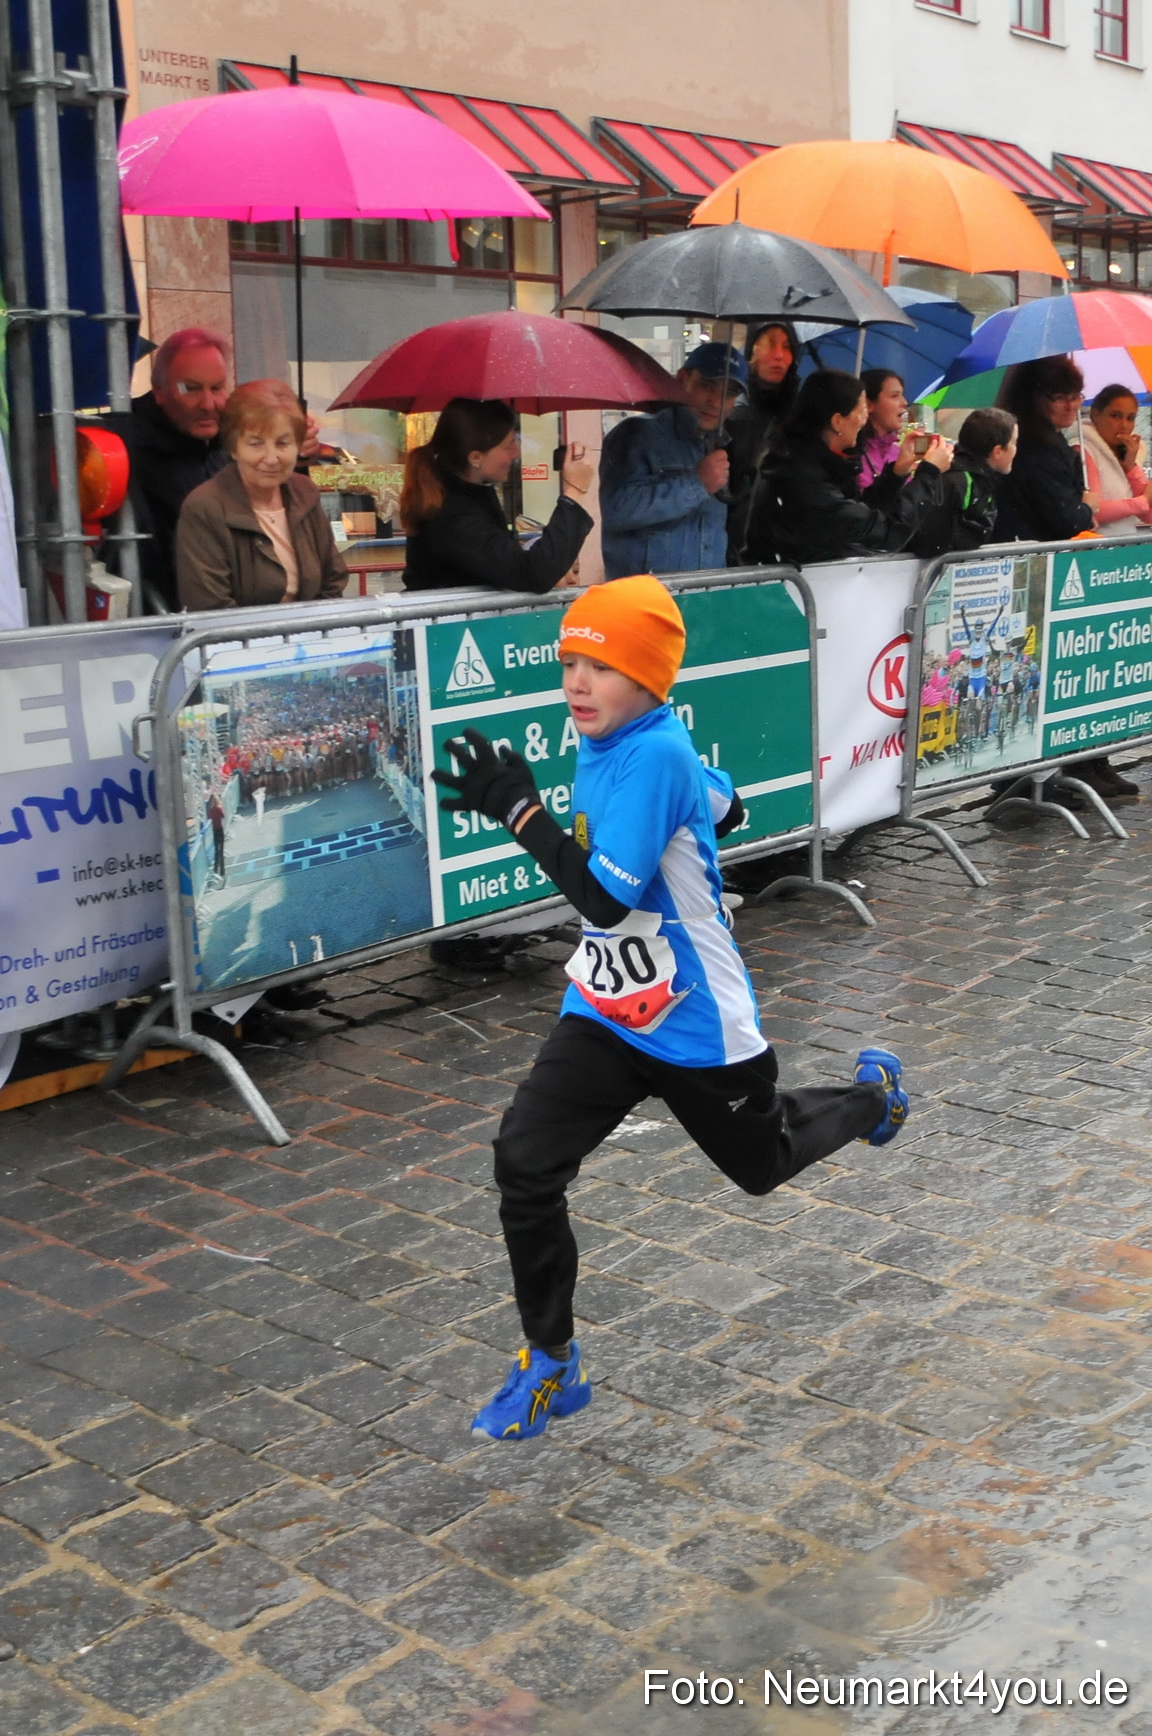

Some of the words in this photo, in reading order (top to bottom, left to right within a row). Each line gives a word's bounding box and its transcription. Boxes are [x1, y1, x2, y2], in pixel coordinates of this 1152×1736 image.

[139, 48, 208, 70] UNTERER
[140, 70, 191, 89] MARKT
[197, 78, 211, 92] 15
[566, 626, 606, 644] odlo
[1056, 625, 1105, 660] Mehr
[1053, 669, 1081, 701] für
[1084, 663, 1110, 694] Ihr
[524, 721, 551, 763] &
[1049, 726, 1077, 748] Miet
[1078, 723, 1088, 741] &
[1089, 714, 1127, 738] Service
[850, 739, 878, 771] KIA
[75, 878, 165, 908] www.sk-tec
[459, 873, 509, 906] Miet
[513, 865, 531, 892] &
[0, 947, 50, 975] Dreh-
[54, 937, 87, 963] und
[25, 984, 40, 1005] &
[46, 963, 141, 999] Gestaltung
